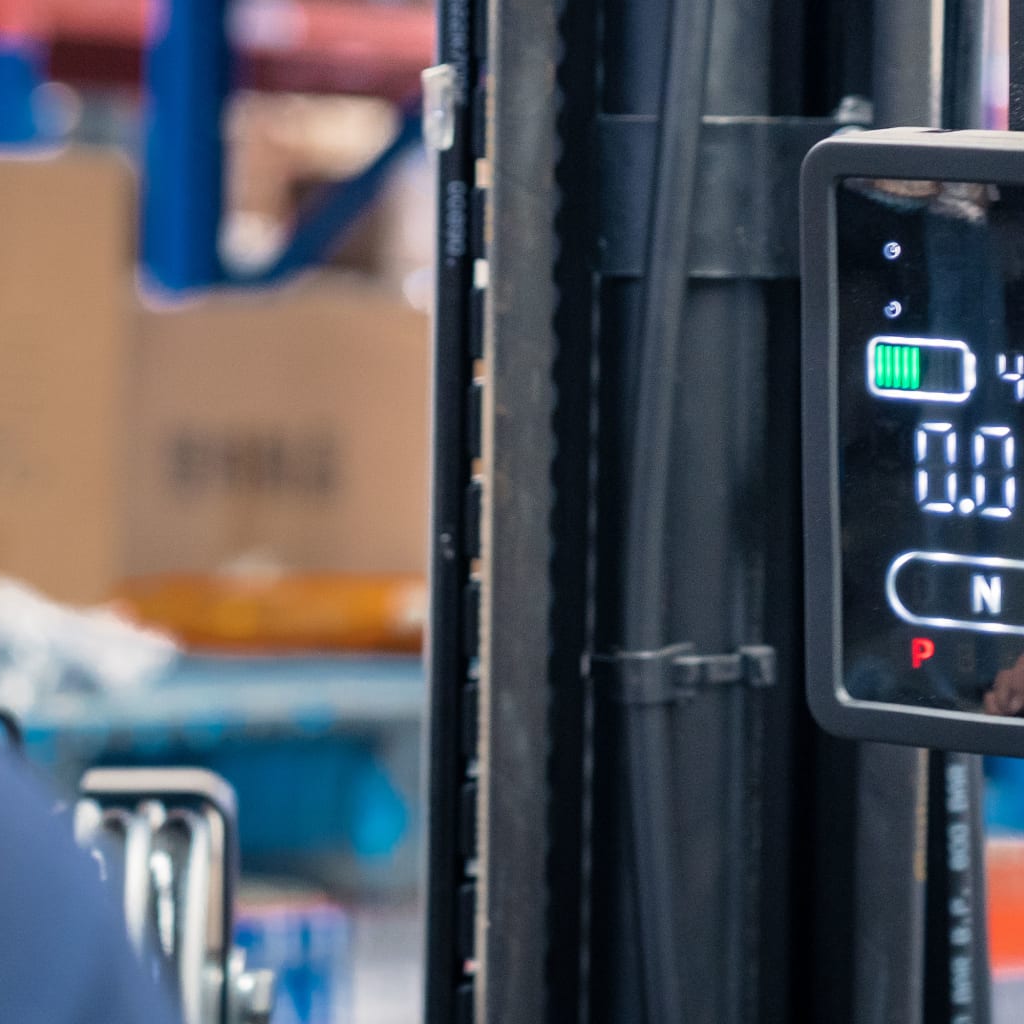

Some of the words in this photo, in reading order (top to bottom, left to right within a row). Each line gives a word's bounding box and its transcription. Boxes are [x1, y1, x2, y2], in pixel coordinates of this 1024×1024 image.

[916, 422, 1016, 518] 0.0
[973, 575, 1002, 614] N
[911, 637, 936, 669] P
